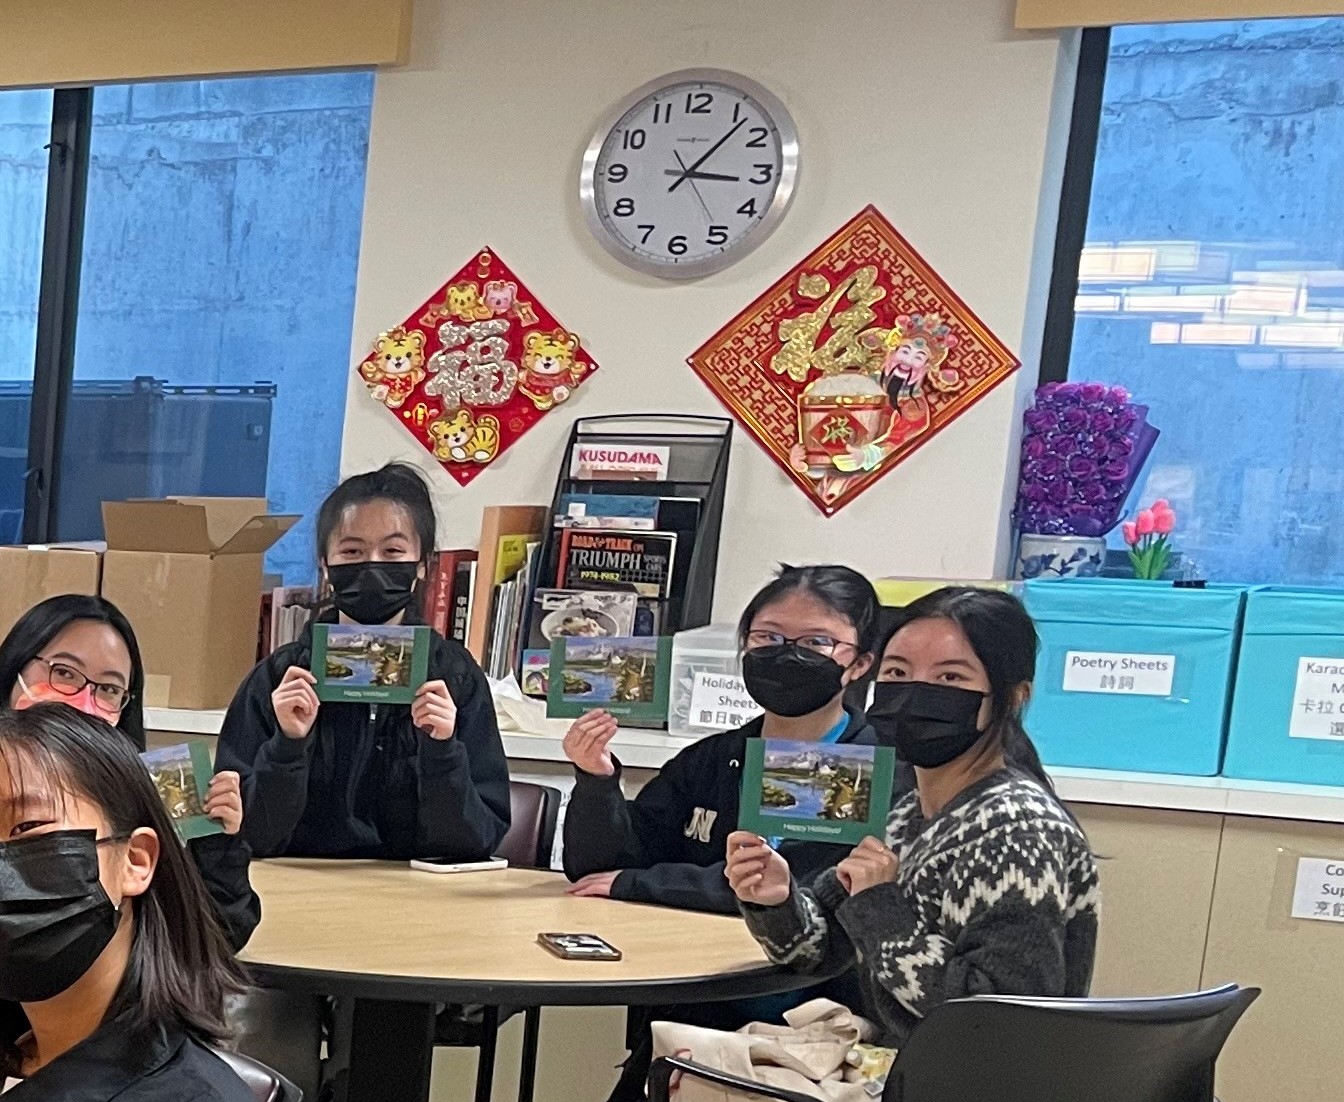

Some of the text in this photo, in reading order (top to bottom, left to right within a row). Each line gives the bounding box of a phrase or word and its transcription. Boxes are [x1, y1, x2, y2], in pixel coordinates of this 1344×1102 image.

[653, 103, 672, 123] 11
[685, 93, 713, 114] 12
[732, 102, 740, 123] 1
[623, 129, 646, 150] 10
[745, 127, 768, 148] 2
[607, 163, 628, 183] 9
[748, 164, 773, 185] 3
[613, 198, 635, 217] 8
[736, 198, 757, 218] 4
[637, 225, 655, 244] 7
[706, 226, 728, 245] 5
[667, 236, 688, 255] 6
[579, 449, 663, 466] KUSUDAMA
[570, 548, 641, 571] TRIUMPH
[1072, 655, 1169, 671] Poetry Sheets
[702, 676, 746, 692] Holiday
[718, 695, 759, 709] Sheets
